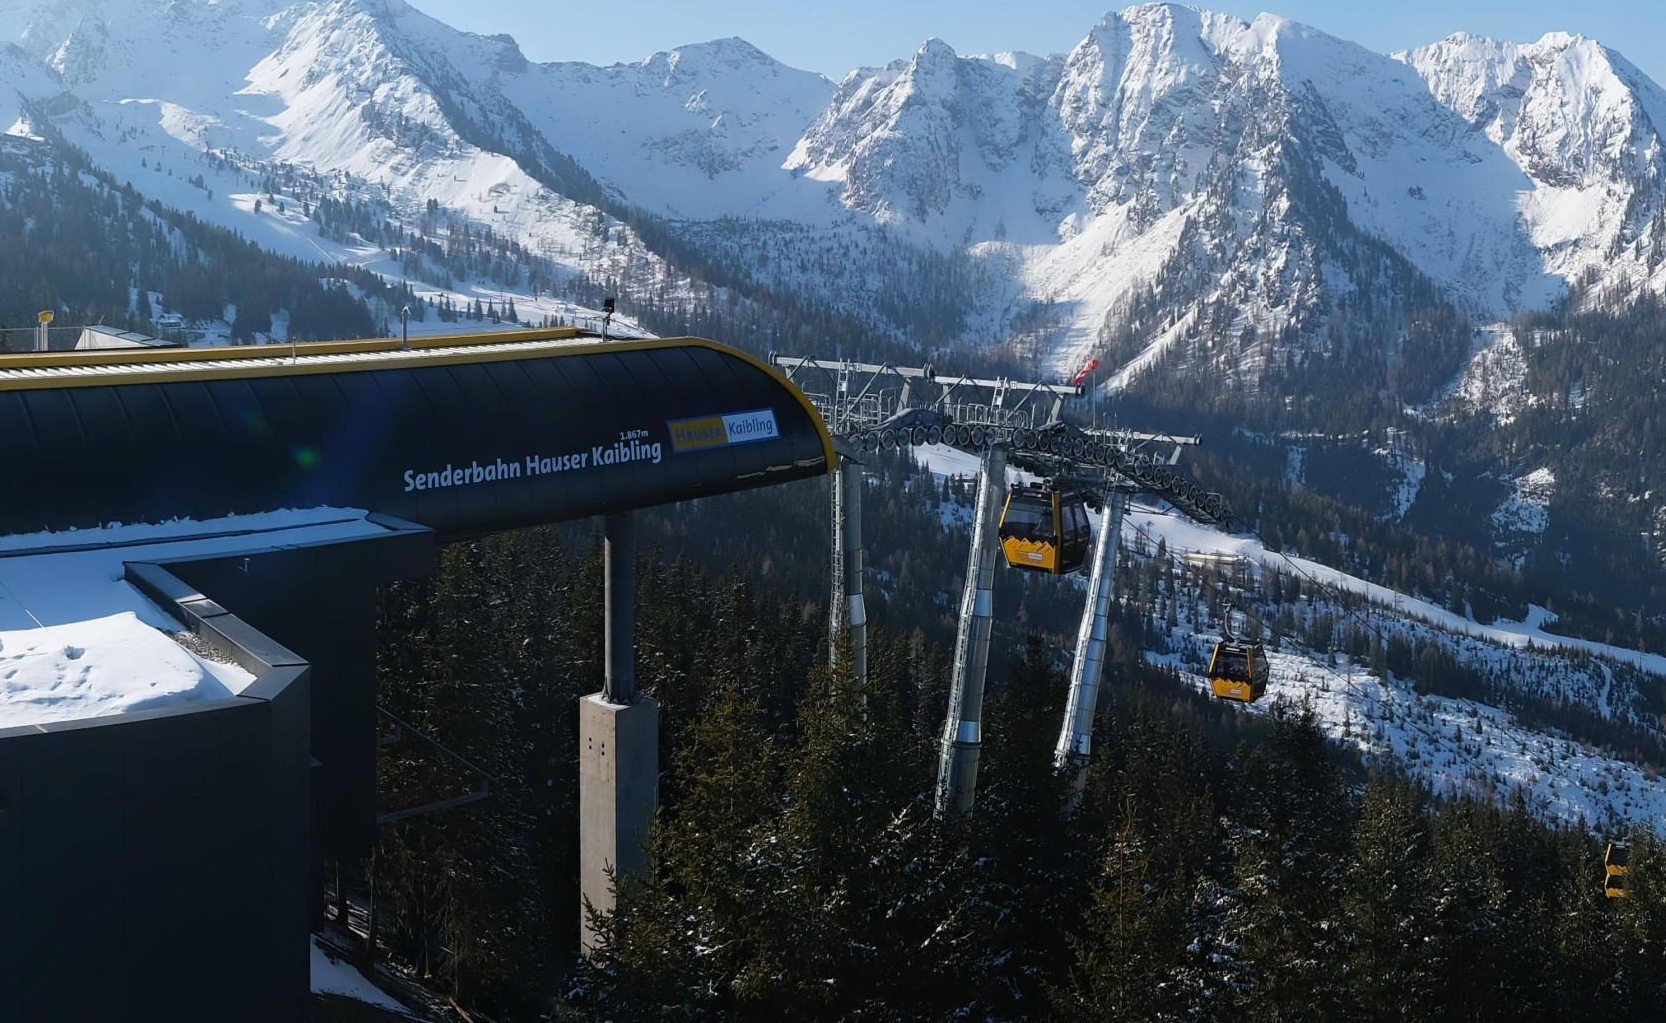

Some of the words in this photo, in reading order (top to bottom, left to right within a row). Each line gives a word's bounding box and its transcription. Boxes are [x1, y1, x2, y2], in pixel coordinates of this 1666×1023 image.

[619, 429, 649, 440] 1.867m
[675, 426, 722, 443] HAUSER
[728, 418, 774, 437] Kaibling
[404, 458, 521, 492] Senderbahn
[526, 451, 588, 476] Hauser
[592, 439, 662, 466] Kaibling
